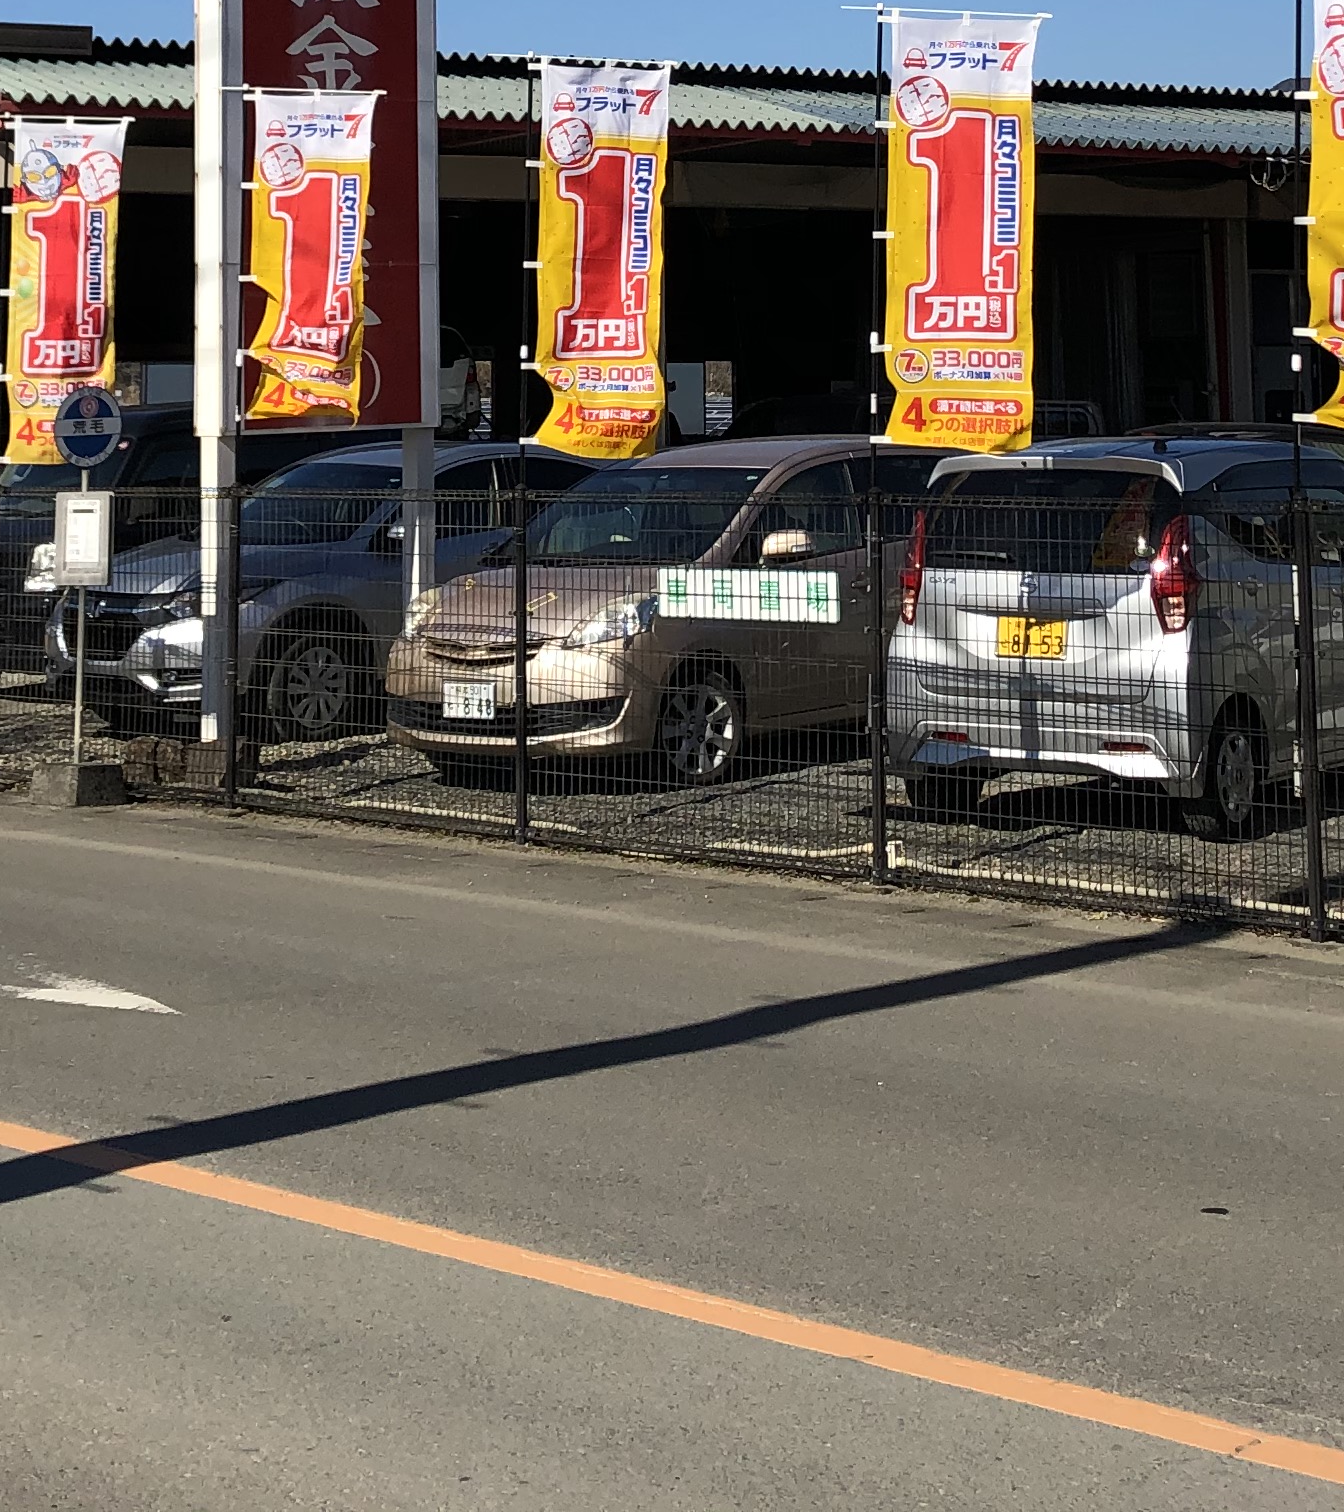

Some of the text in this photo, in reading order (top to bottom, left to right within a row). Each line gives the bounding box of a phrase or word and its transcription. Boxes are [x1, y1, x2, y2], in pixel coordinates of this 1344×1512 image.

[929, 42, 1029, 71] フラット7
[576, 89, 663, 115] フラット7
[287, 113, 368, 139] フラット7
[997, 119, 1016, 243] 月々コミコミ
[631, 157, 653, 269] 月々コミコミ
[923, 296, 987, 329] 万円
[569, 319, 626, 349] 万円
[33, 340, 80, 365] 万円
[262, 381, 286, 408] 4
[936, 399, 1017, 414] 満了時に選べる
[555, 402, 574, 434] 4
[901, 397, 927, 432] 4
[667, 578, 828, 613] 車両置場
